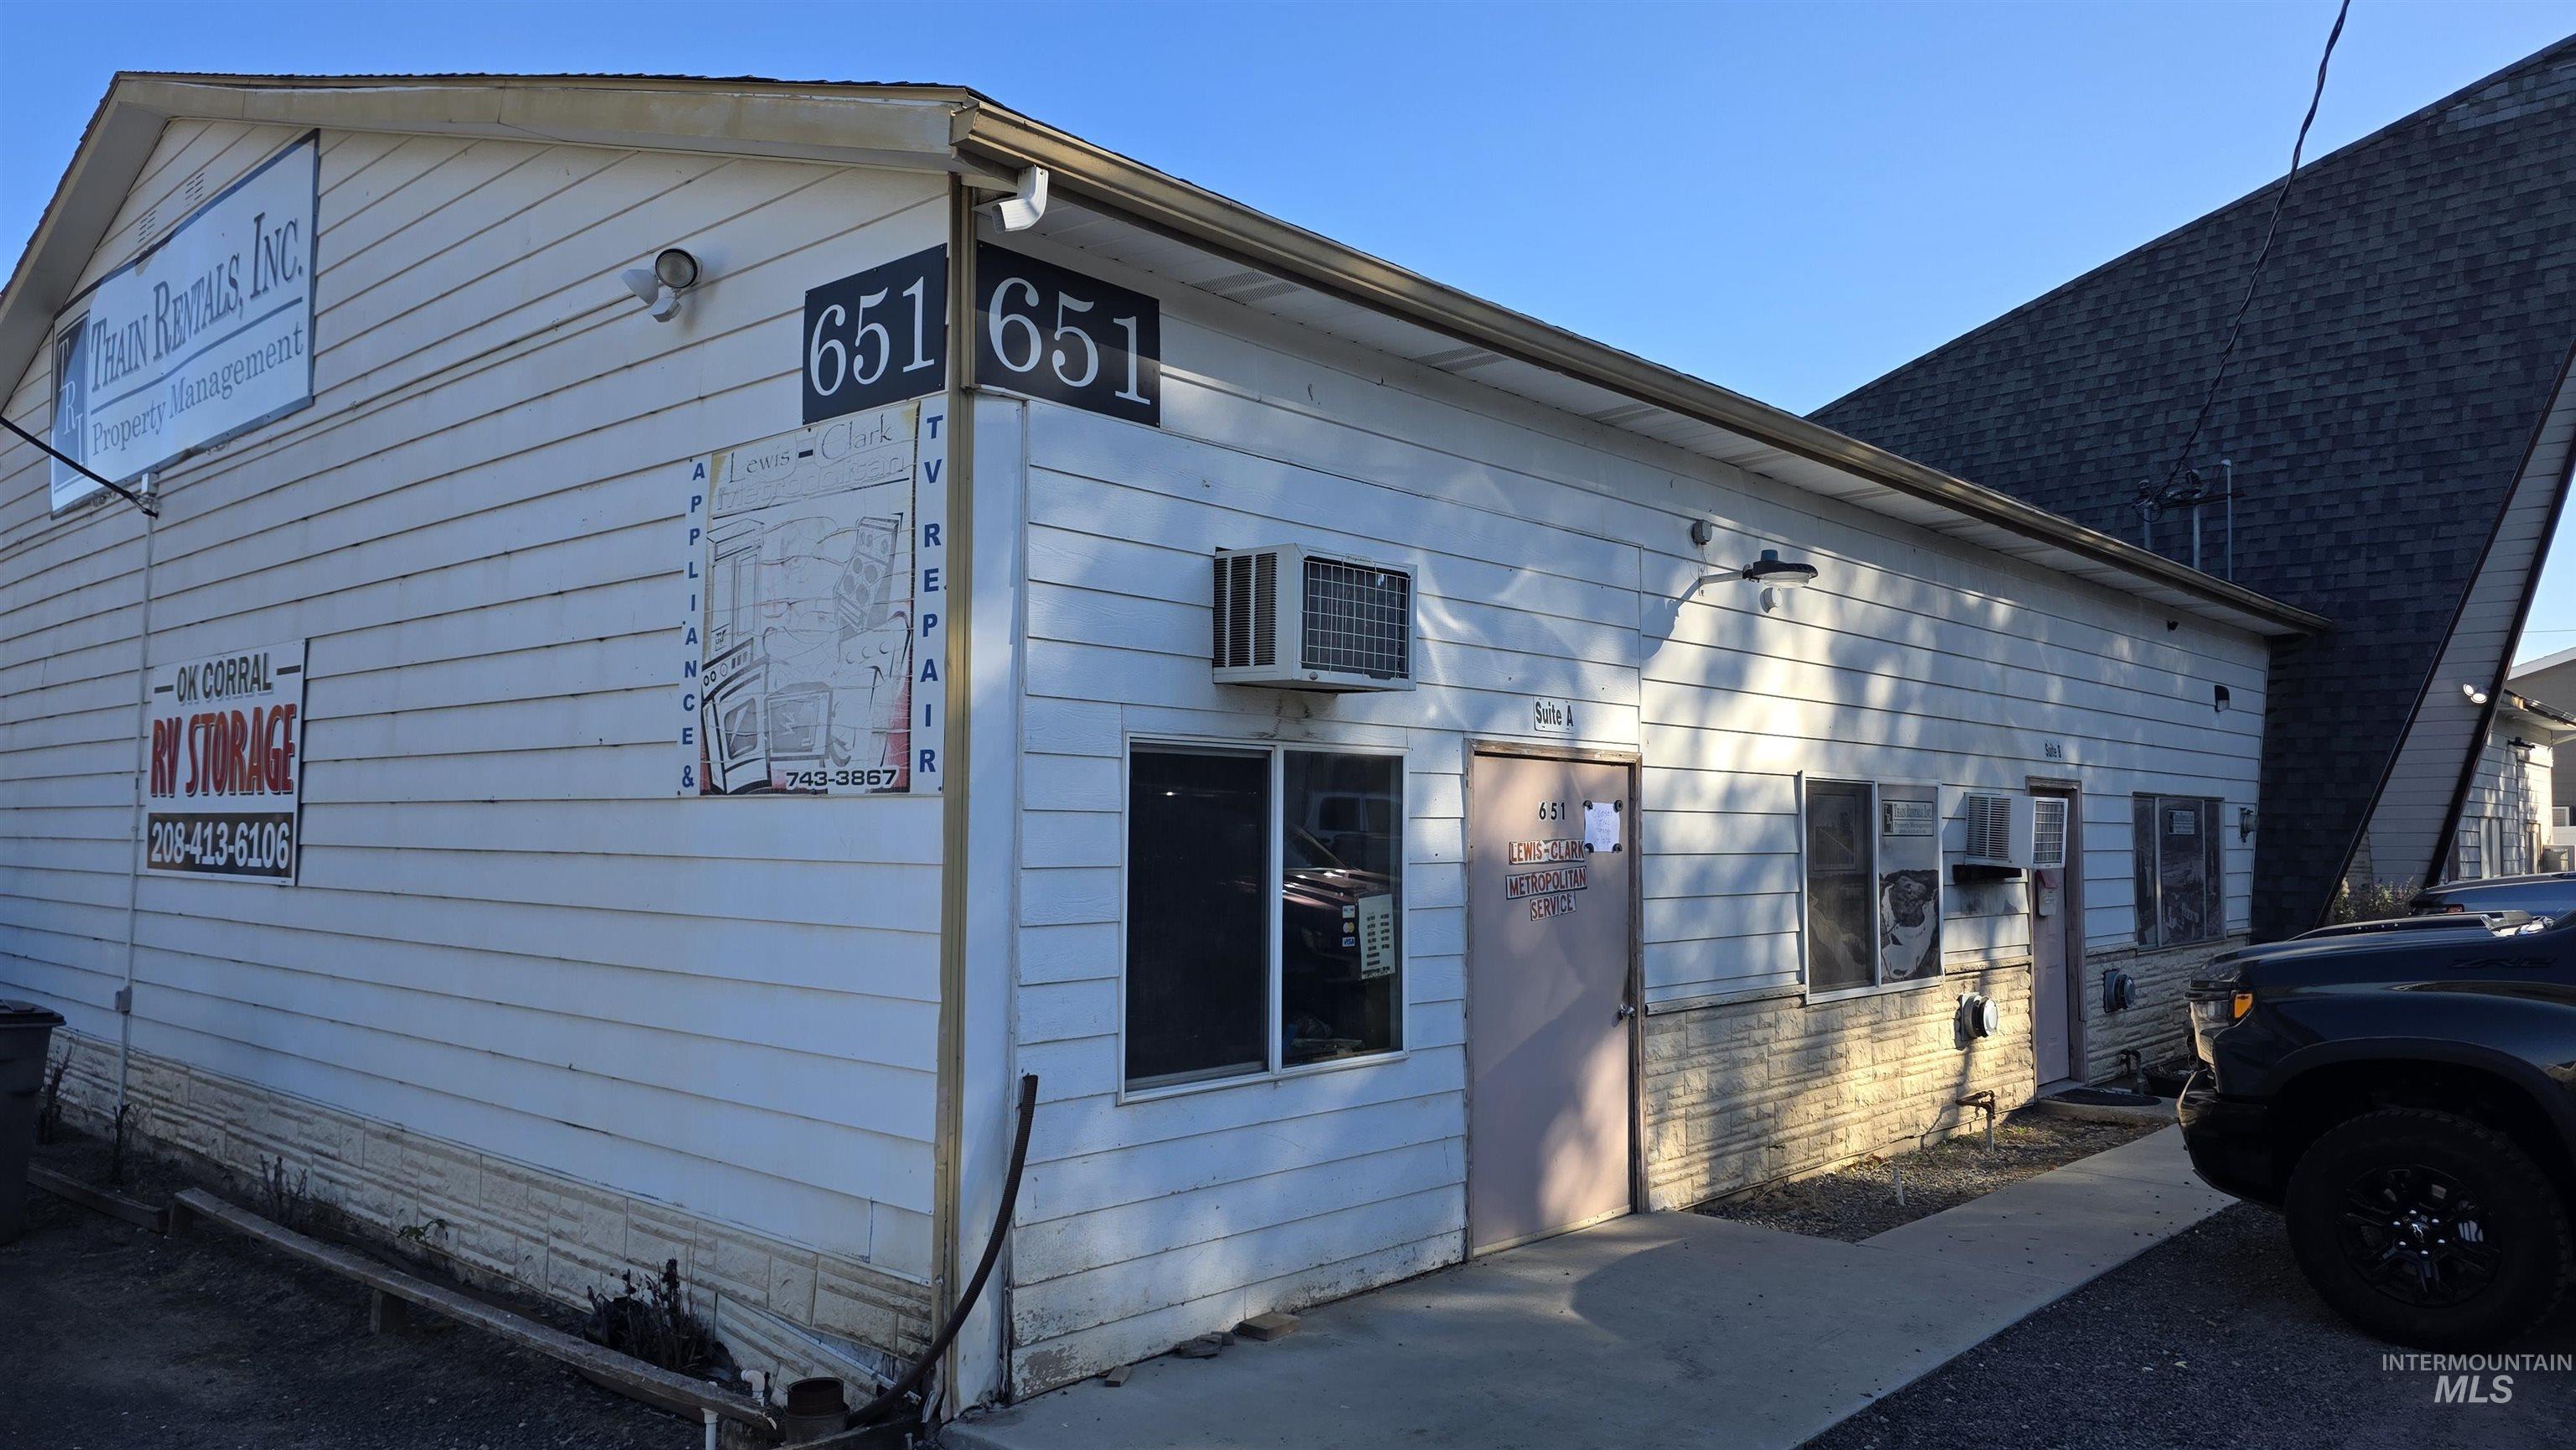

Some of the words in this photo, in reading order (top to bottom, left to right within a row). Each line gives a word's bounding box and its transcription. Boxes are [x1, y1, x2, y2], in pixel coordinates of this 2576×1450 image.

[810, 276, 934, 397] 651
[989, 277, 1150, 405] 651
[92, 400, 166, 455] Property
[169, 321, 304, 420] Management
[730, 445, 790, 483] Lewis
[822, 413, 892, 460] Clark
[923, 415, 943, 484] TV
[683, 462, 704, 745] APPLIANCE
[177, 665, 199, 702] OK
[202, 652, 273, 699] CORRAL
[919, 523, 941, 773] REPAIR
[1535, 701, 1561, 725] Suite
[1566, 704, 1573, 726] A
[150, 716, 181, 798] RV
[185, 704, 297, 797] STORAGE
[682, 771, 694, 788] &
[787, 769, 897, 786] 743-3867
[1539, 802, 1566, 820] 651
[151, 821, 289, 869] 208-413-6106
[1510, 868, 1587, 897] METROPOLITAN
[1531, 894, 1573, 919] SERVICE
